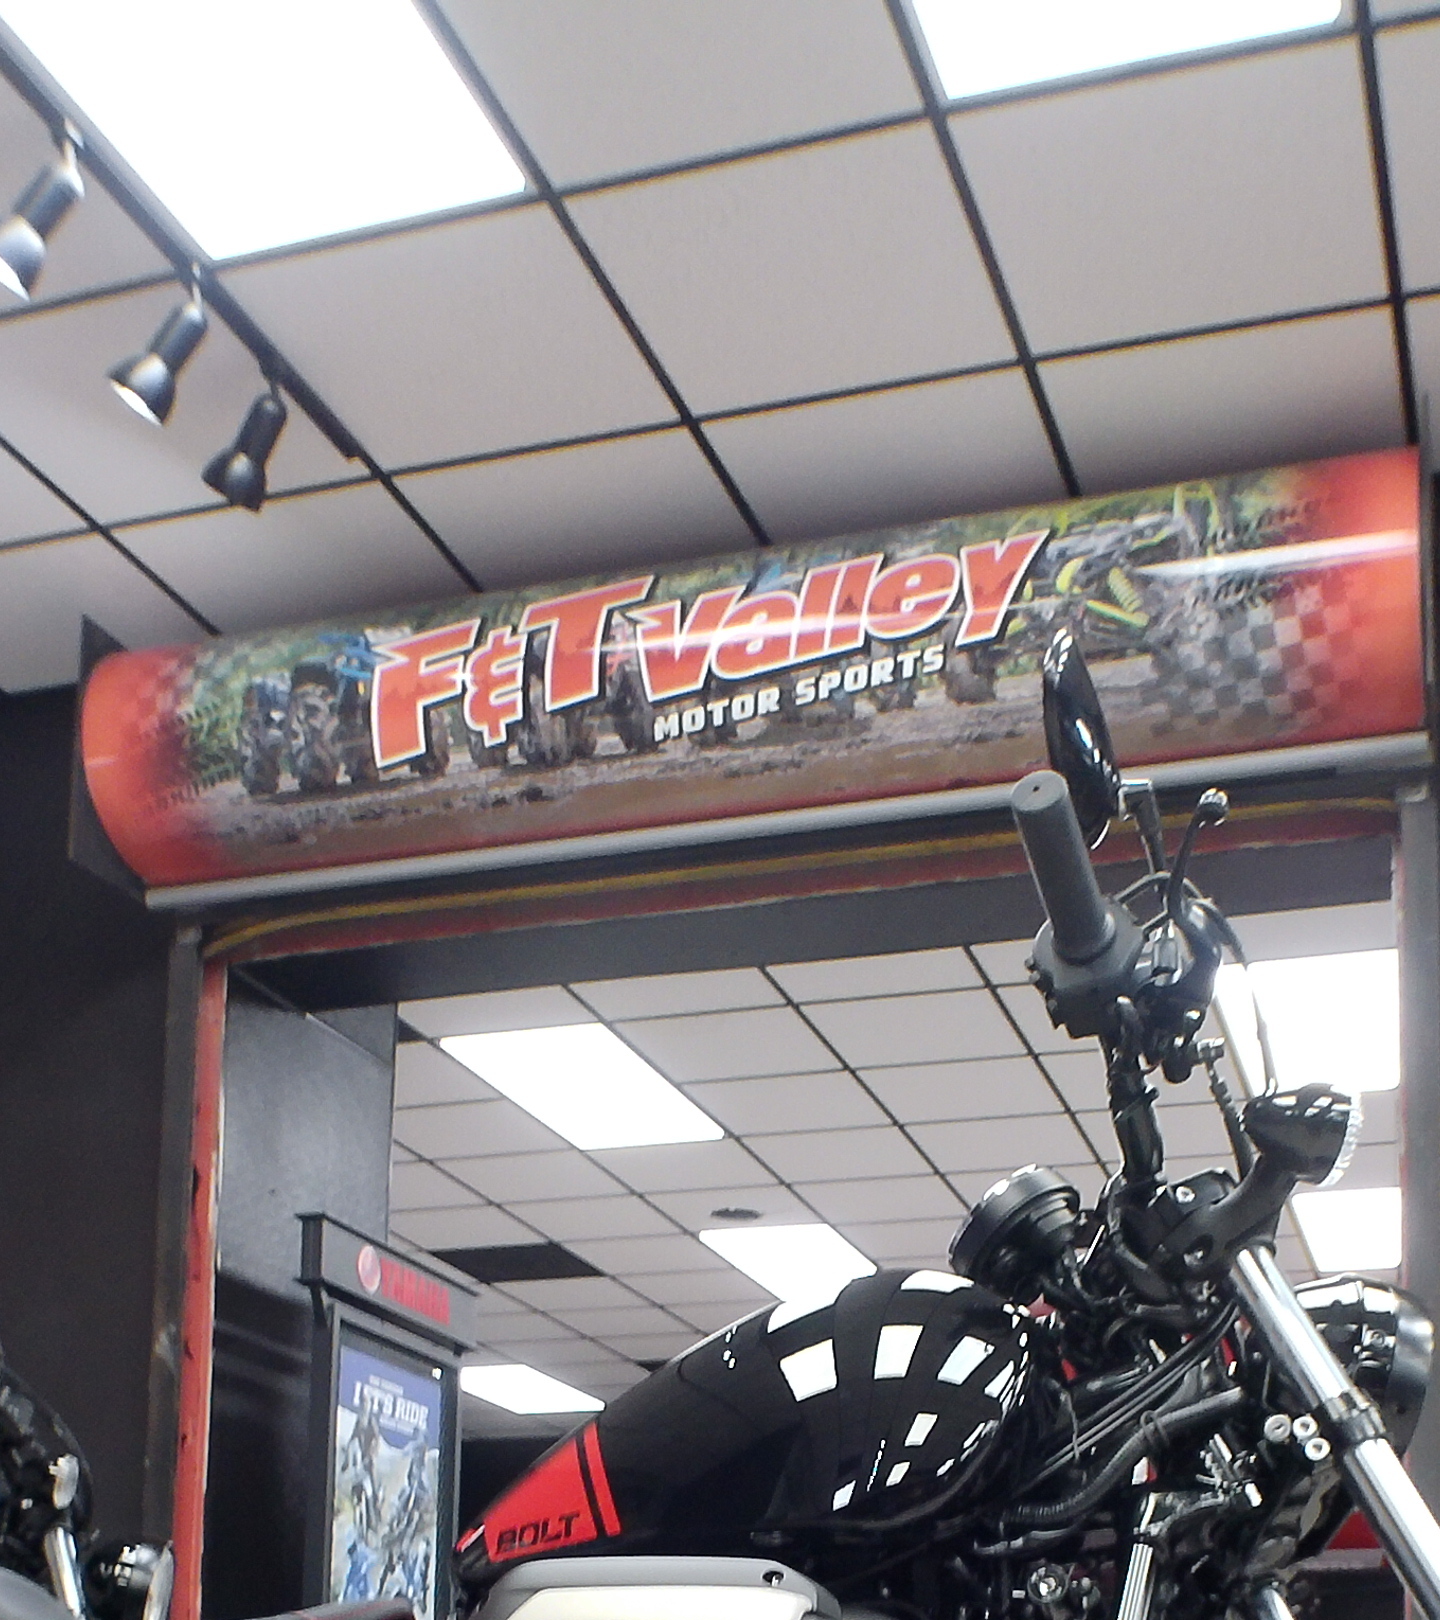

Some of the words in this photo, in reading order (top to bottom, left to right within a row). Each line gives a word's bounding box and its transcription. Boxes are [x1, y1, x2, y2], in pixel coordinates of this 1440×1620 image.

[371, 574, 656, 770] F&T
[623, 528, 1050, 702] Valley
[653, 686, 781, 743] MOTOR
[795, 643, 945, 706] SPORTS
[380, 1257, 451, 1327] YAMAHA
[394, 1397, 430, 1430] RIDE
[496, 1511, 580, 1553] BOLT
